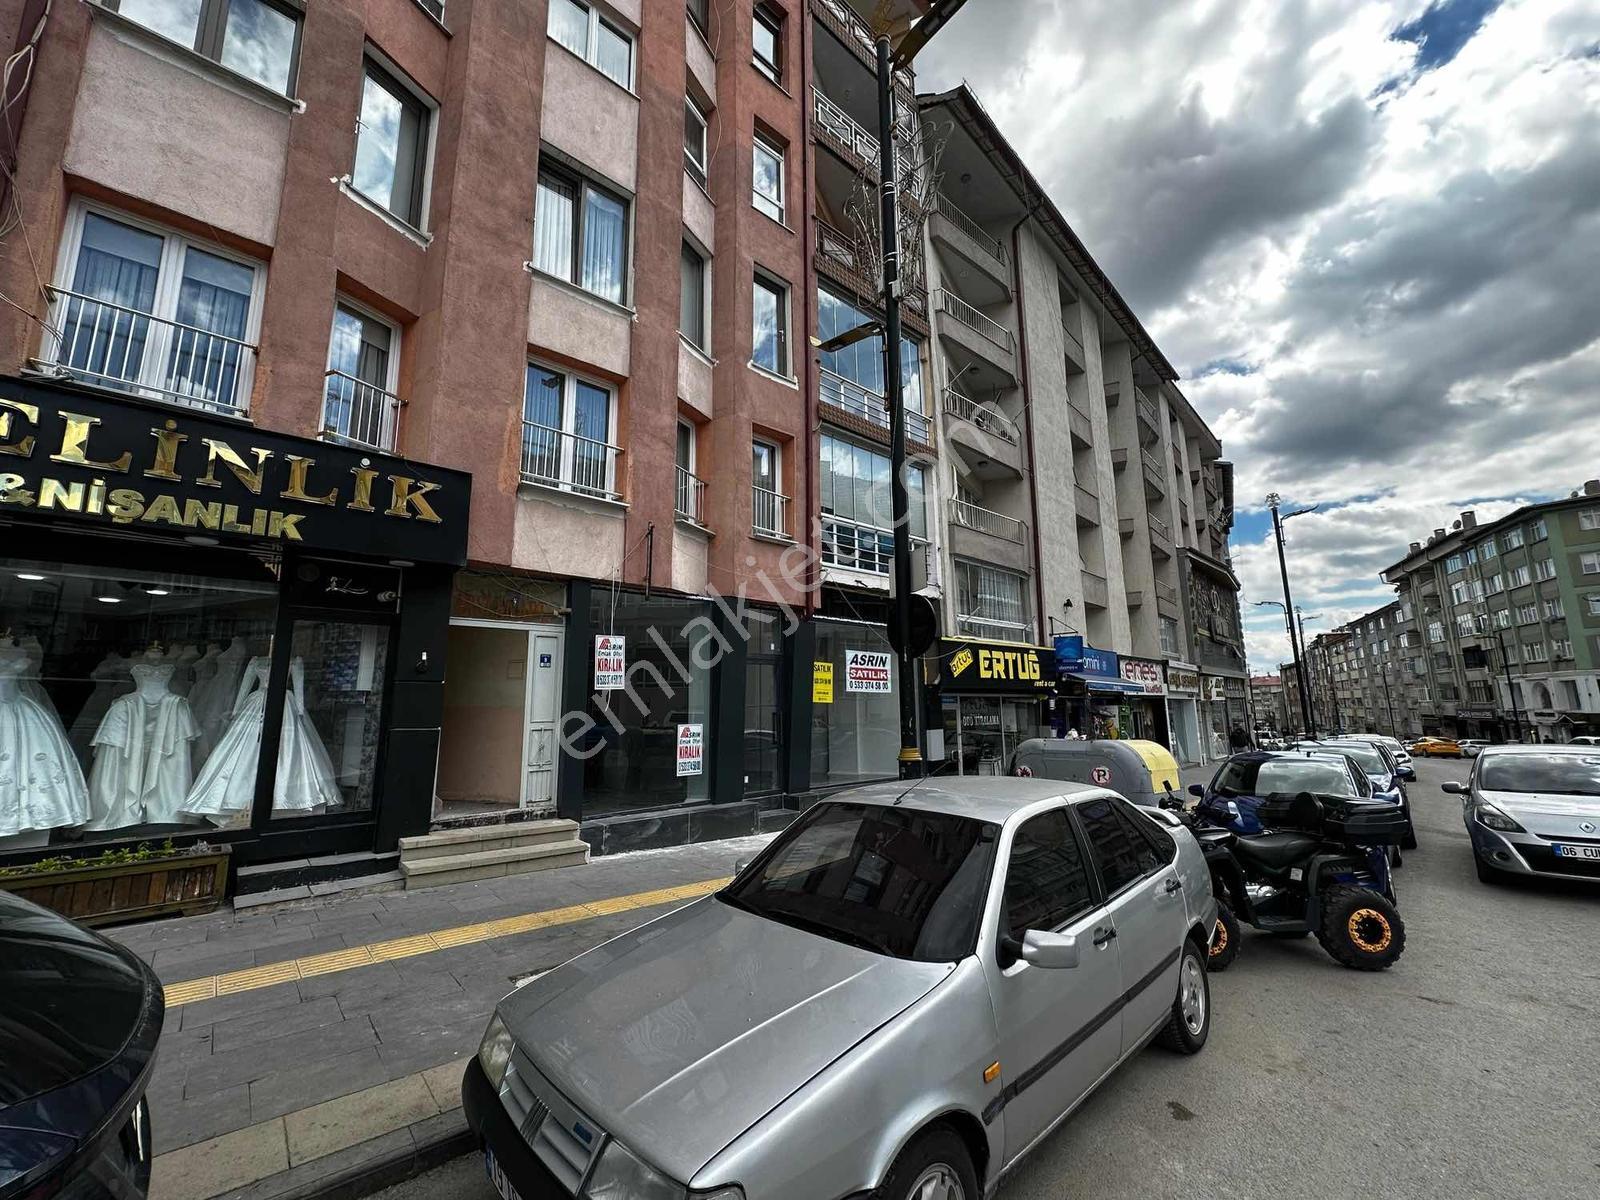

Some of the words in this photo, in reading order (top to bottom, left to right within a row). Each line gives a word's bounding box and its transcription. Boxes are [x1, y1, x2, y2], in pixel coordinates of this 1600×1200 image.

[850, 653, 888, 667] ASRIN
[978, 649, 1041, 680] ERTUĞ
[850, 669, 888, 680] SATILIK
[1562, 846, 1577, 857] 06
[1583, 848, 1600, 859] CU
